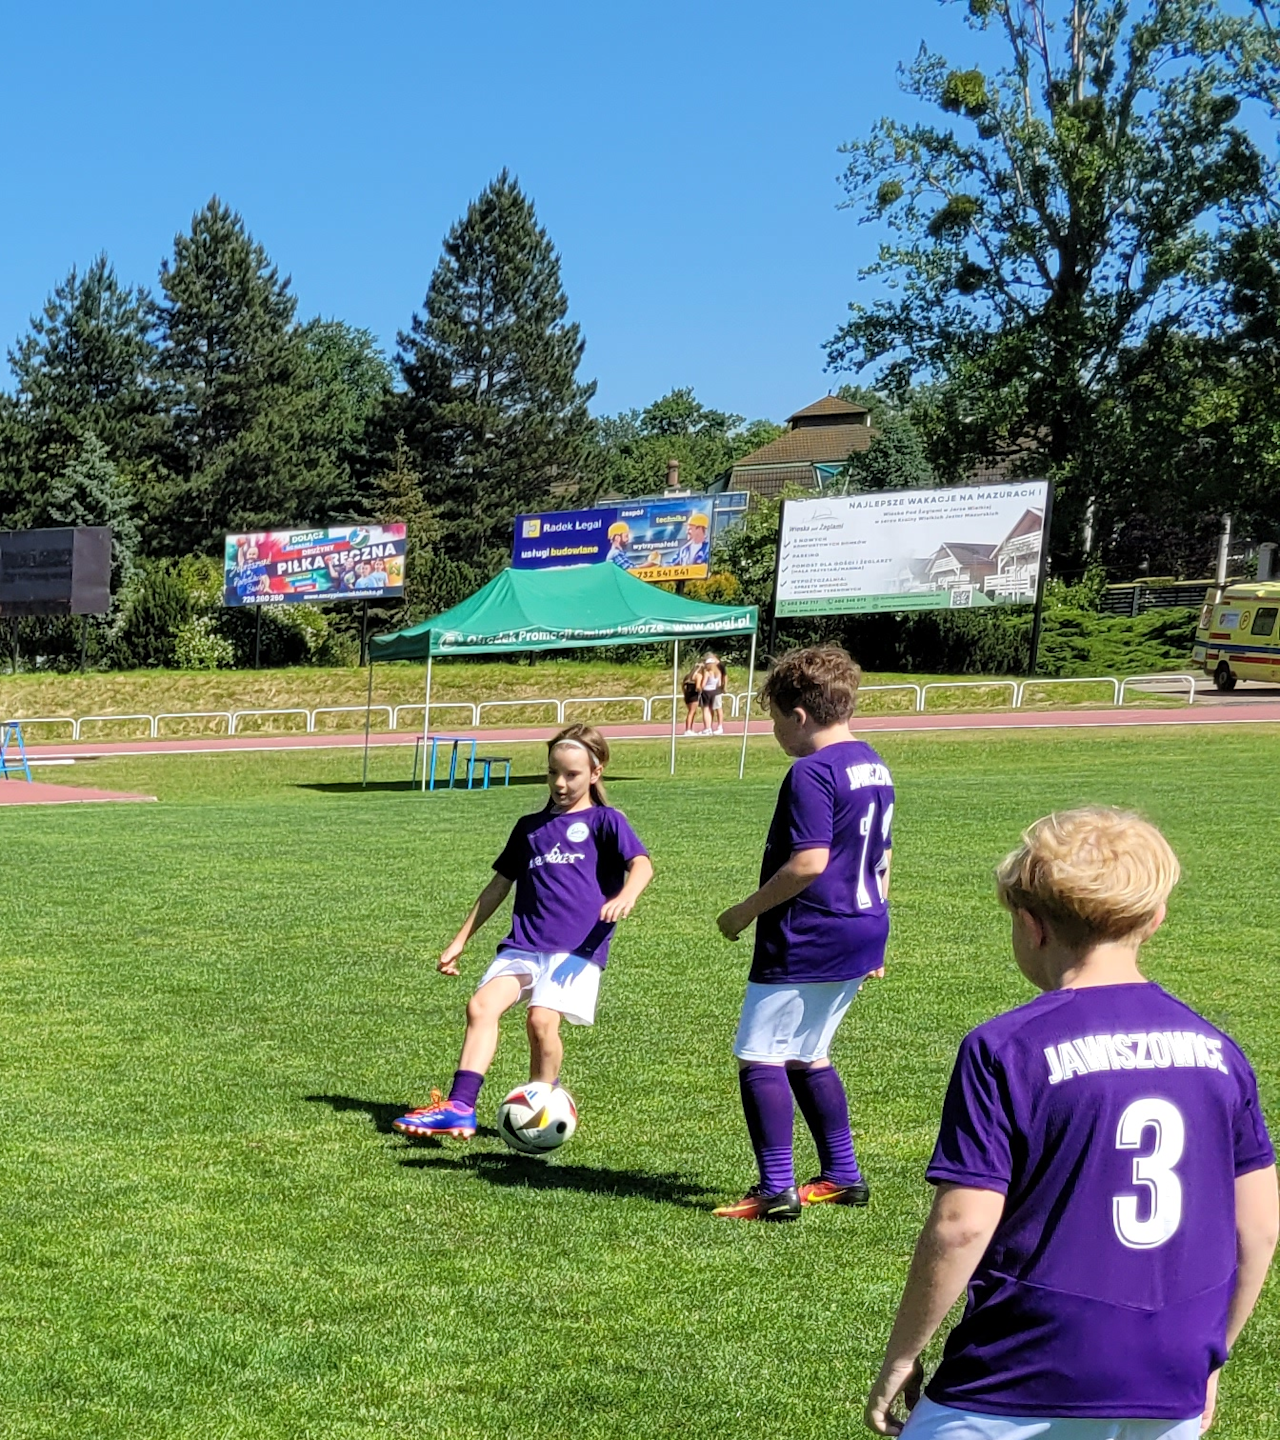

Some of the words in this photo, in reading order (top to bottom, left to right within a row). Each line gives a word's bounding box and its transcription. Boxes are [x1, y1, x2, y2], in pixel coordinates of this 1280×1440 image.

[849, 498, 904, 510] NAJLEPSZE
[908, 494, 956, 506] WAKACJE
[959, 493, 974, 503] NA
[977, 489, 1036, 501] MAZURACH
[621, 509, 644, 518] zespół
[655, 515, 687, 524] technika
[543, 522, 573, 533] Radek
[575, 519, 602, 531] Legal
[291, 531, 324, 544] DOŁĄCZ
[302, 544, 335, 556] DRUŻYNY
[521, 548, 550, 559] usługi
[550, 546, 599, 557] budowlane
[277, 556, 326, 576] PIŁKA
[637, 571, 654, 579] 732
[656, 569, 672, 577] 541
[674, 568, 690, 576] 541
[466, 632, 516, 645] Ośrodek
[518, 628, 572, 642] Promocji
[573, 626, 614, 639] Gminy
[617, 622, 665, 635] Jaworze
[671, 613, 750, 633] www.opgj.pl
[1043, 1031, 1229, 1085] JAWISZOWICE
[1112, 1098, 1185, 1250] 3
